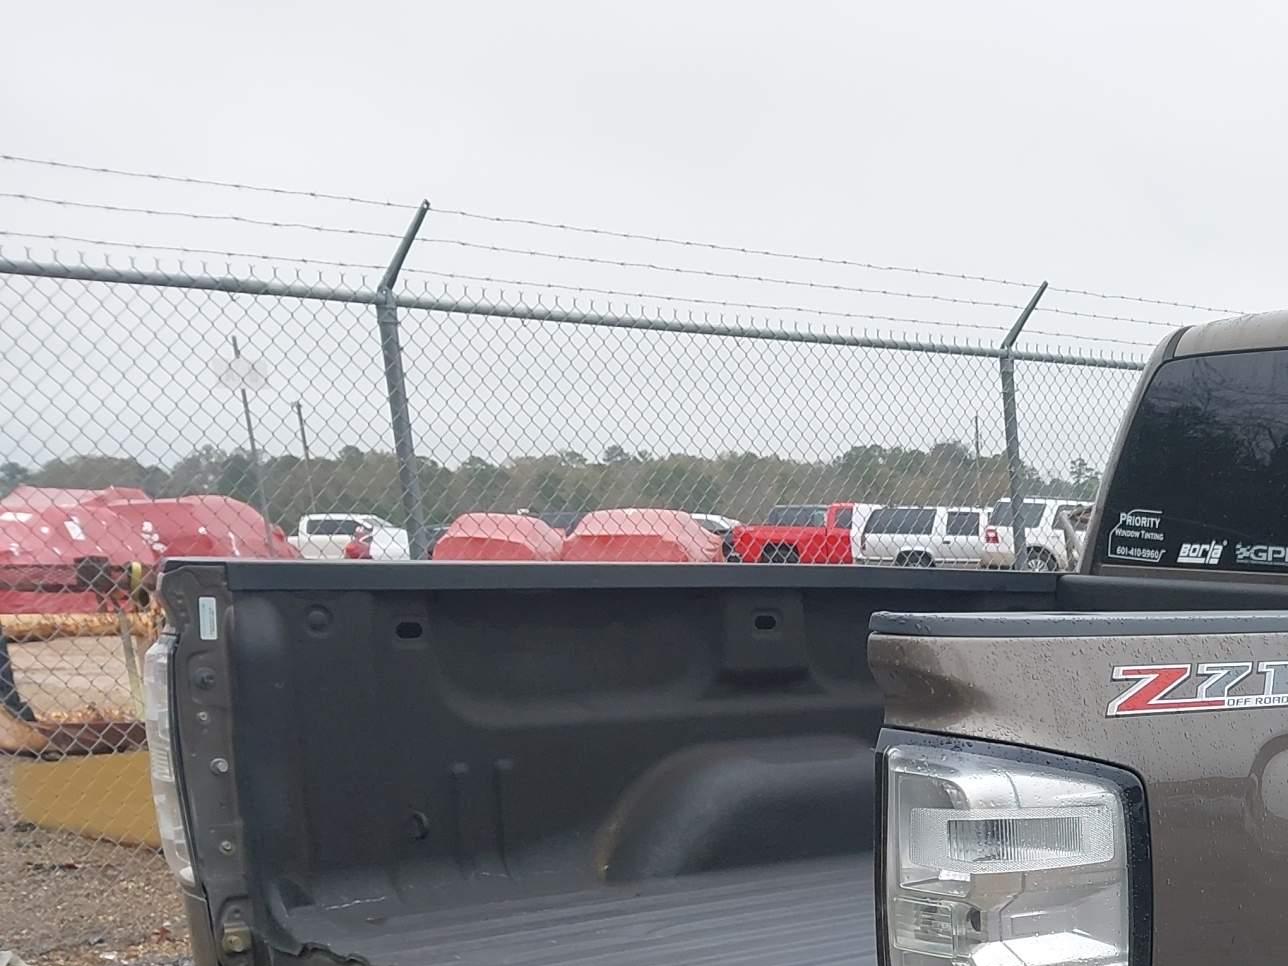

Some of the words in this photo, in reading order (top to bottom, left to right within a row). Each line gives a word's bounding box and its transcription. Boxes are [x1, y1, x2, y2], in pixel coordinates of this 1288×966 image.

[1119, 512, 1160, 528] PRIORITY
[1227, 698, 1251, 707] OFF
[1255, 695, 1288, 705] ROAD
